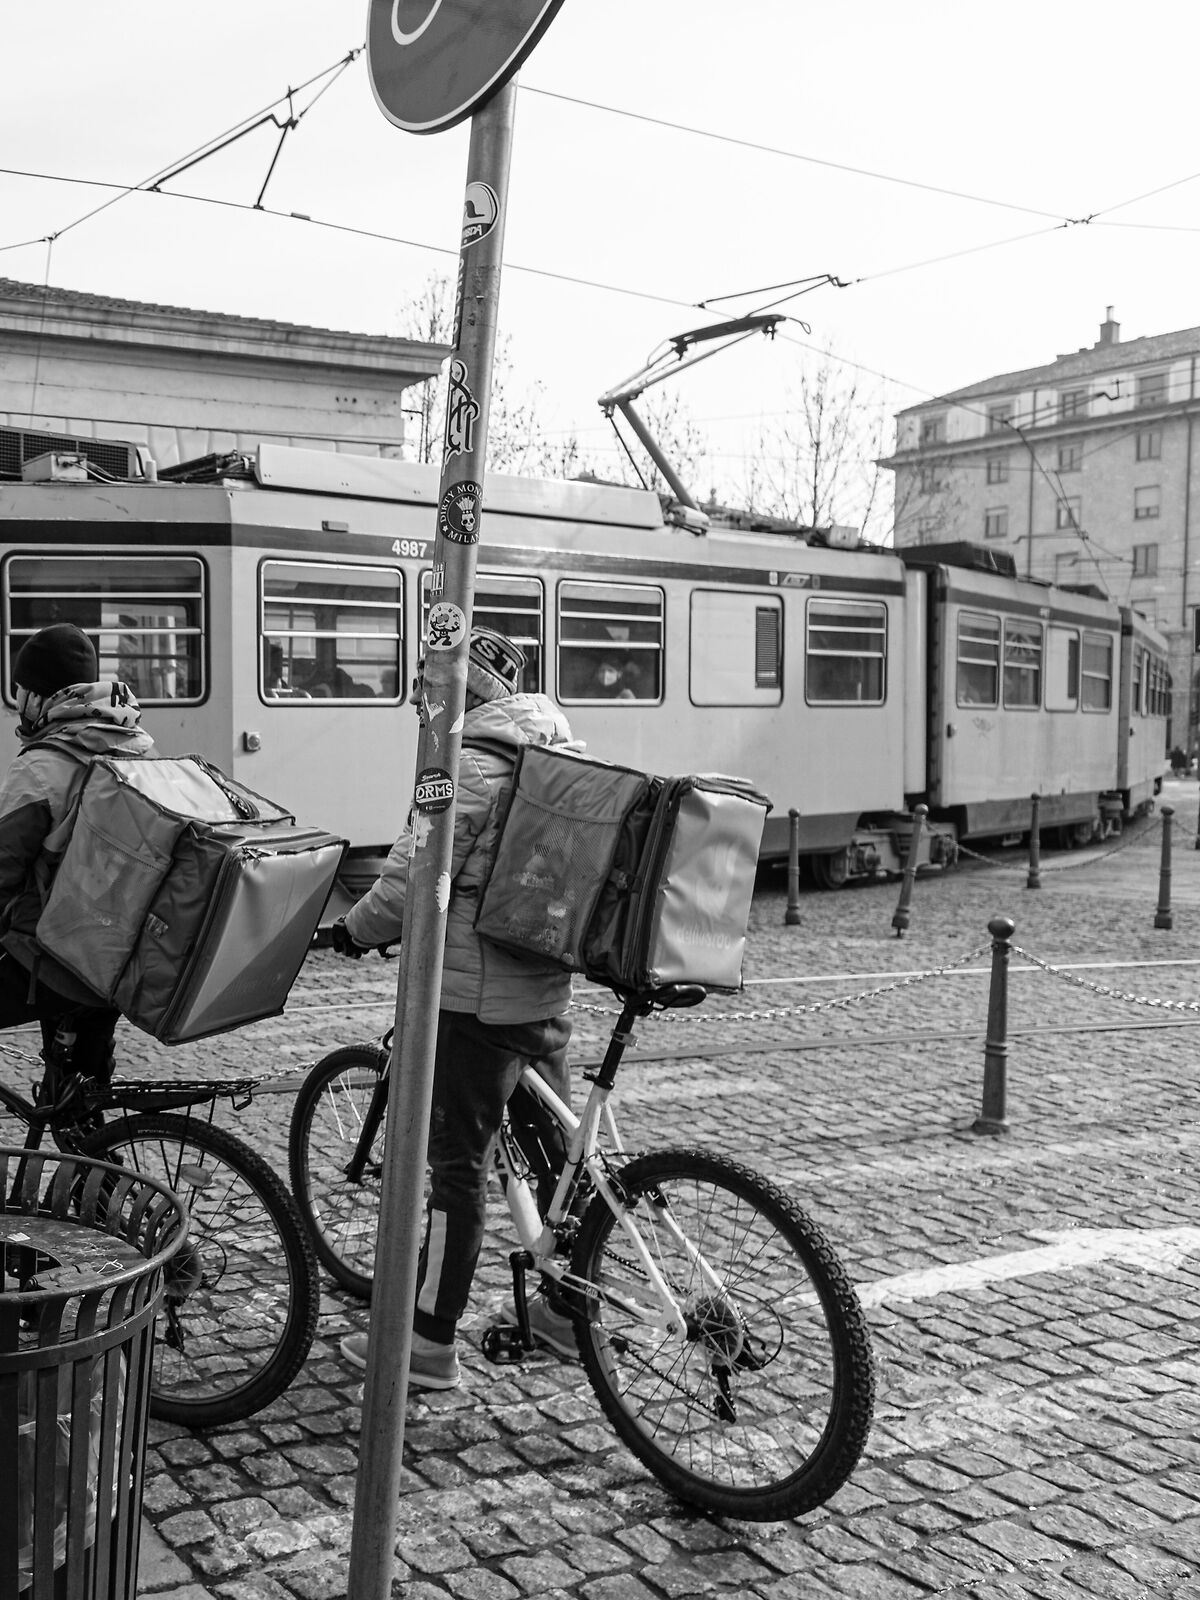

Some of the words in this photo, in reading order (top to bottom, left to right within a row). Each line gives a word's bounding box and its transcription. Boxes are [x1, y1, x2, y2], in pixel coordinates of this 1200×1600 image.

[439, 490, 455, 523] DIRTY
[447, 530, 480, 543] MILAN
[391, 538, 428, 558] 4987
